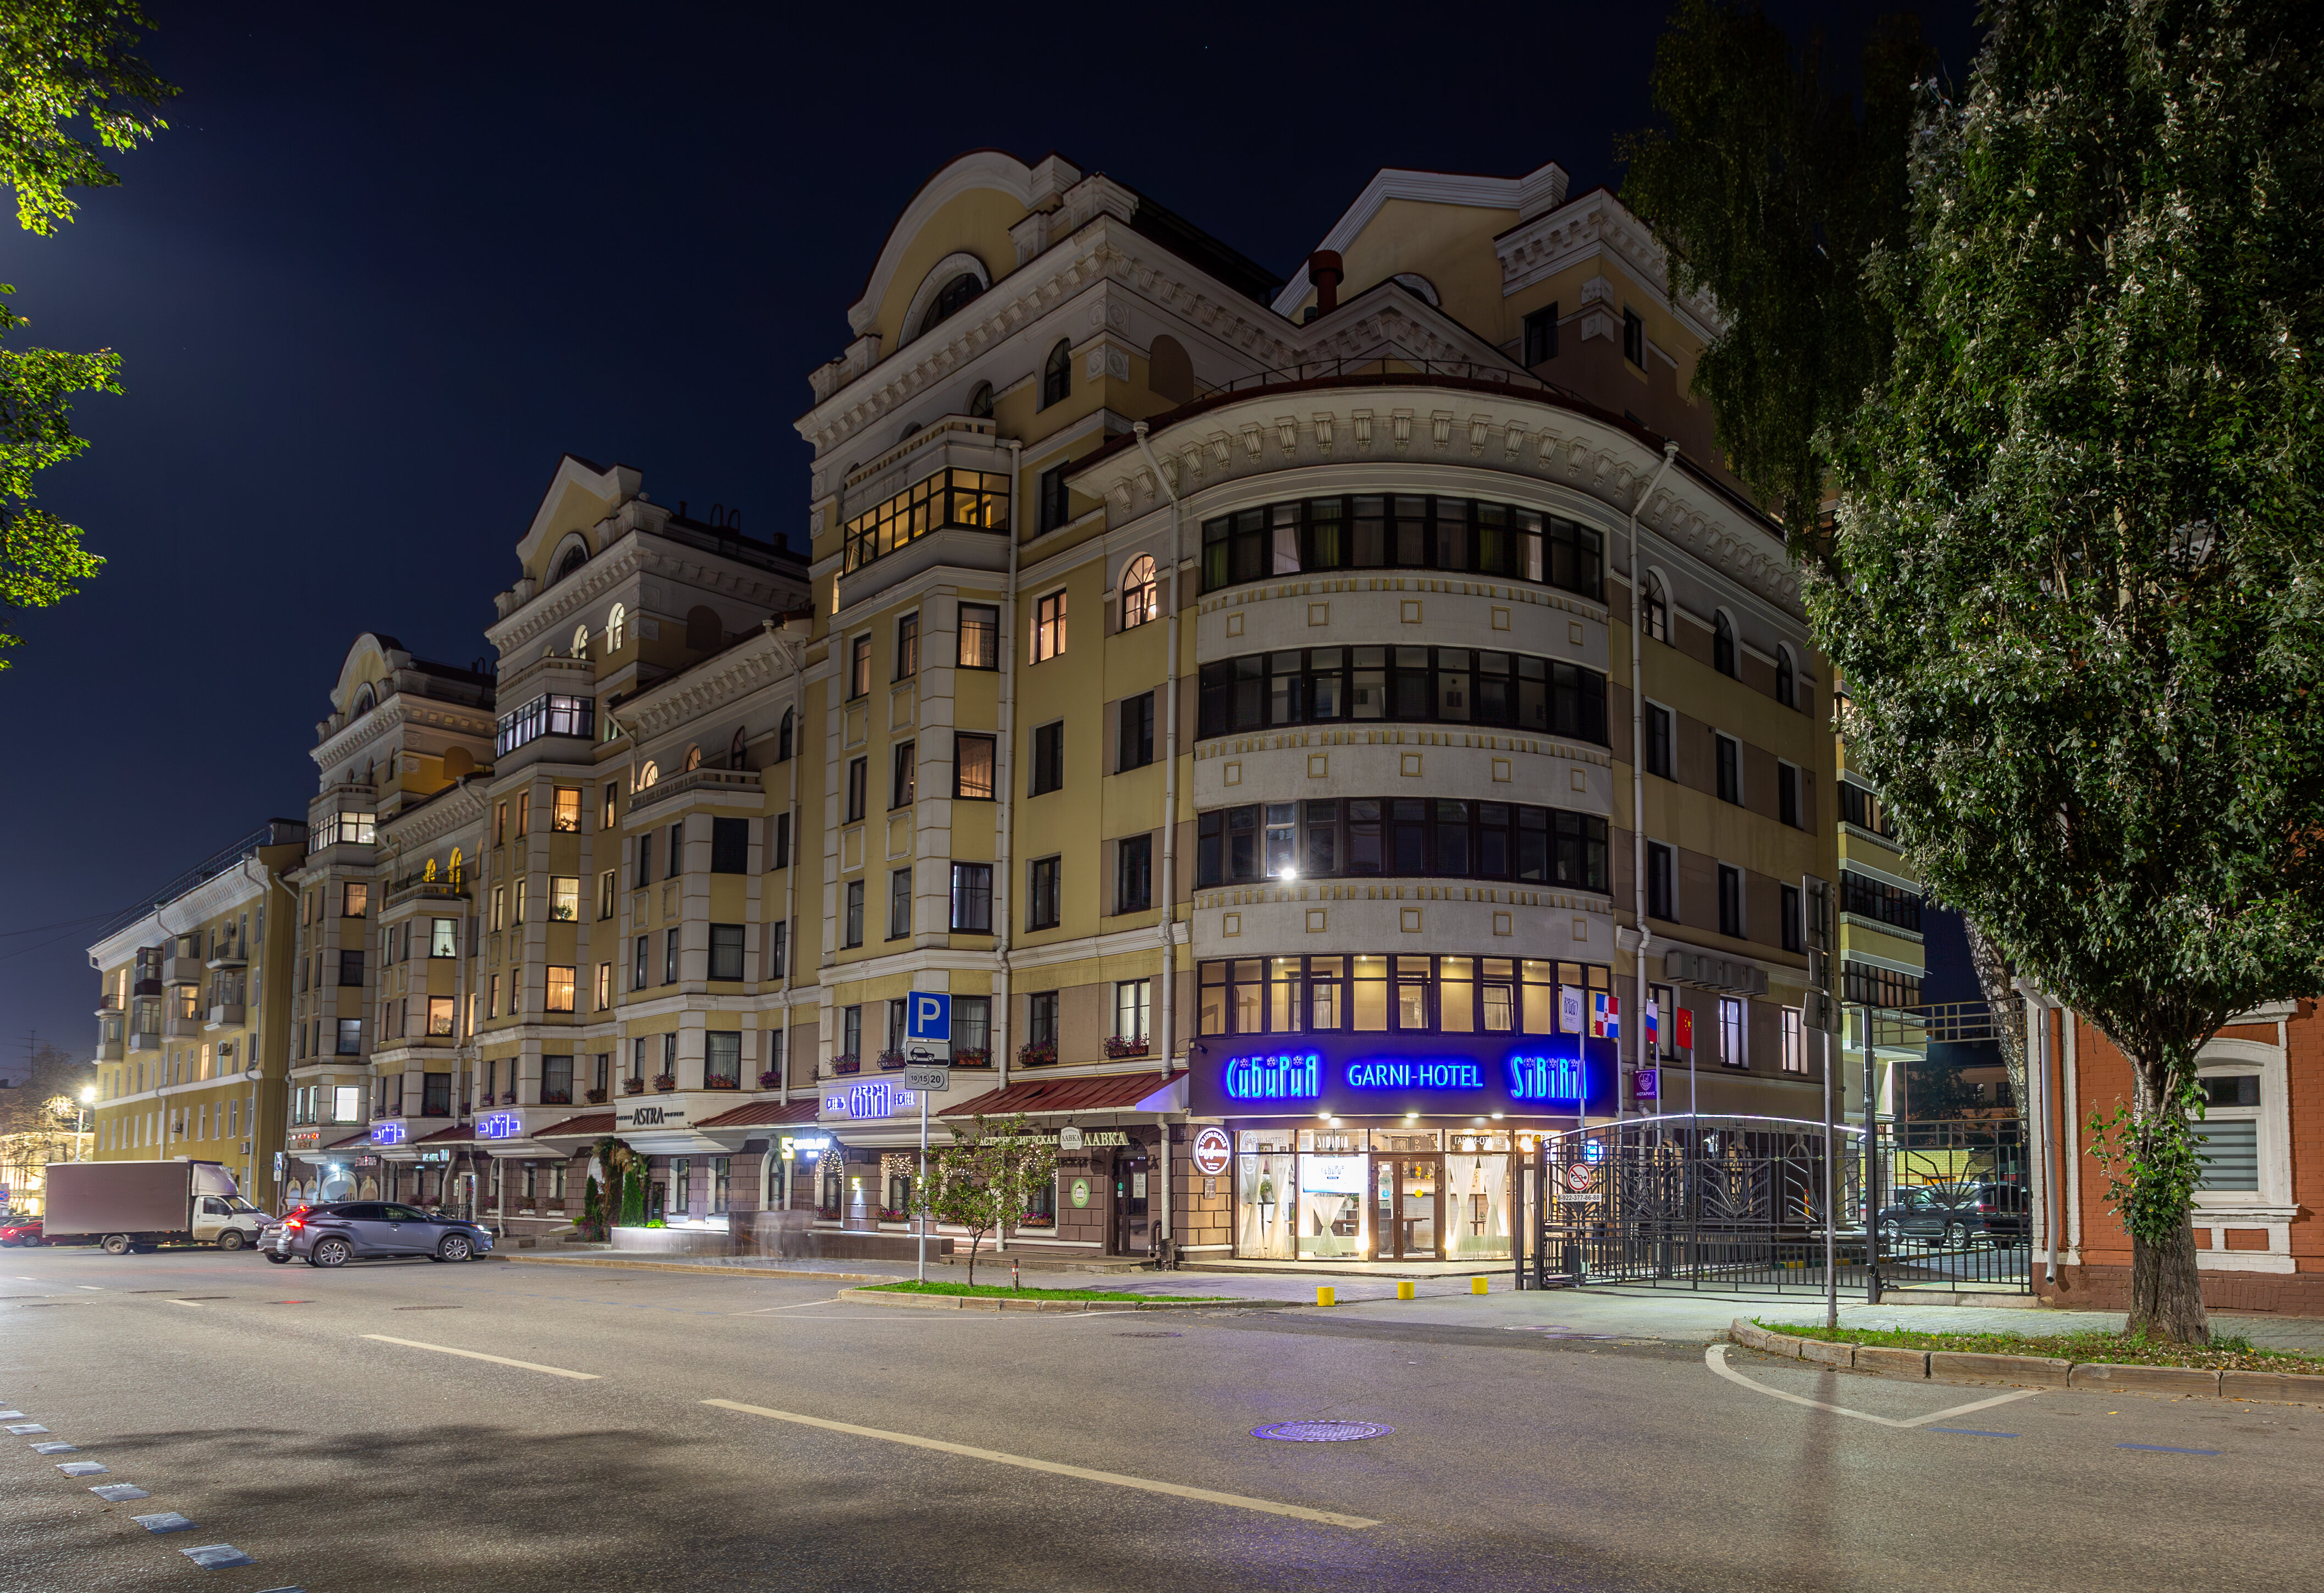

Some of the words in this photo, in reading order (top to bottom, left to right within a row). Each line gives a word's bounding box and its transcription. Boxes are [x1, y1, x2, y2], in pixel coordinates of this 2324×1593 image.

[918, 997, 941, 1033] P
[930, 1075, 941, 1083] 20
[1349, 1065, 1483, 1086] GARNI-HOTEL
[632, 1107, 664, 1125] ASTRA
[1083, 1131, 1130, 1146] ЛАВКА
[1245, 1137, 1285, 1146] GARNI-HOTEL
[1455, 1136, 1502, 1145] ГАРИ-ОТЛЬ
